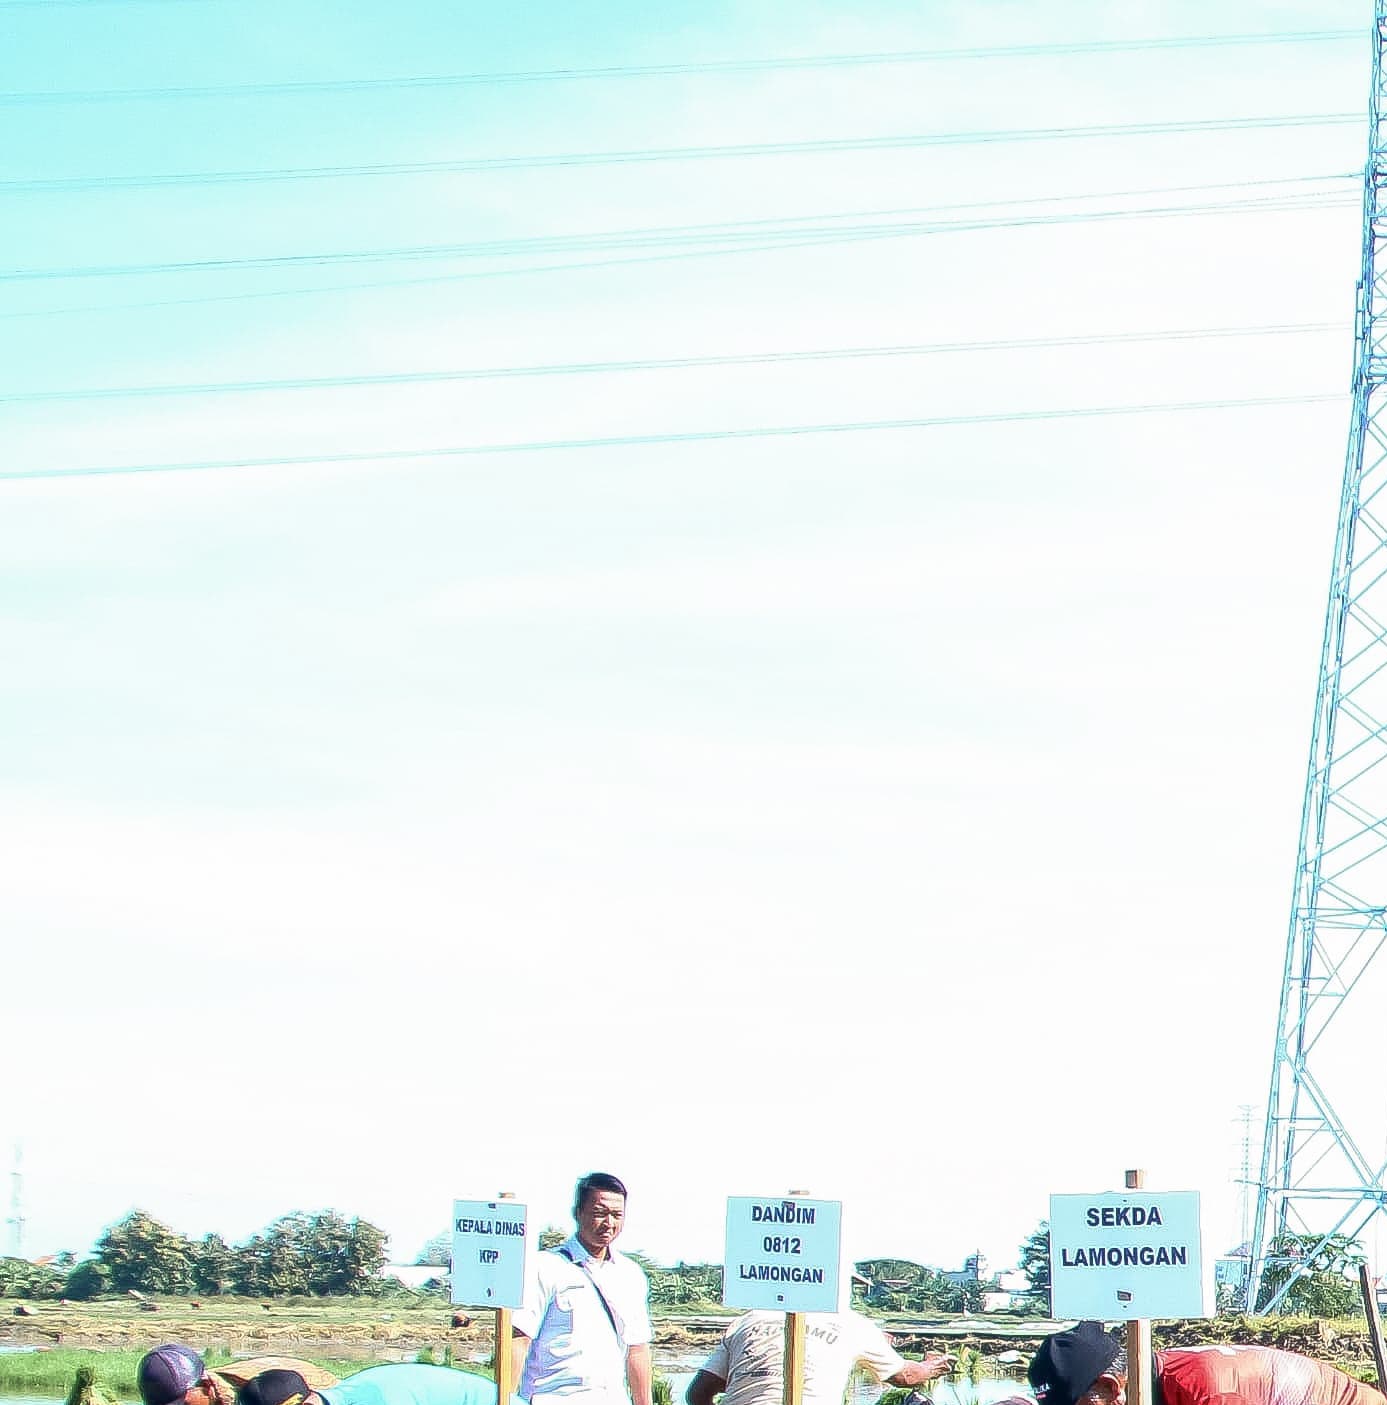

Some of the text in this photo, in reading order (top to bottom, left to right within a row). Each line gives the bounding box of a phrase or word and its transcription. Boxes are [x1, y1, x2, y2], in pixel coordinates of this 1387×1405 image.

[751, 1205, 816, 1225] DANDIM
[1086, 1206, 1163, 1227] SEKDA
[456, 1219, 526, 1237] KEPALA DINAS
[763, 1236, 802, 1254] 0812
[479, 1249, 499, 1264] KPP
[1061, 1246, 1188, 1267] LAMONGAN
[740, 1264, 824, 1284] LAMONGAN
